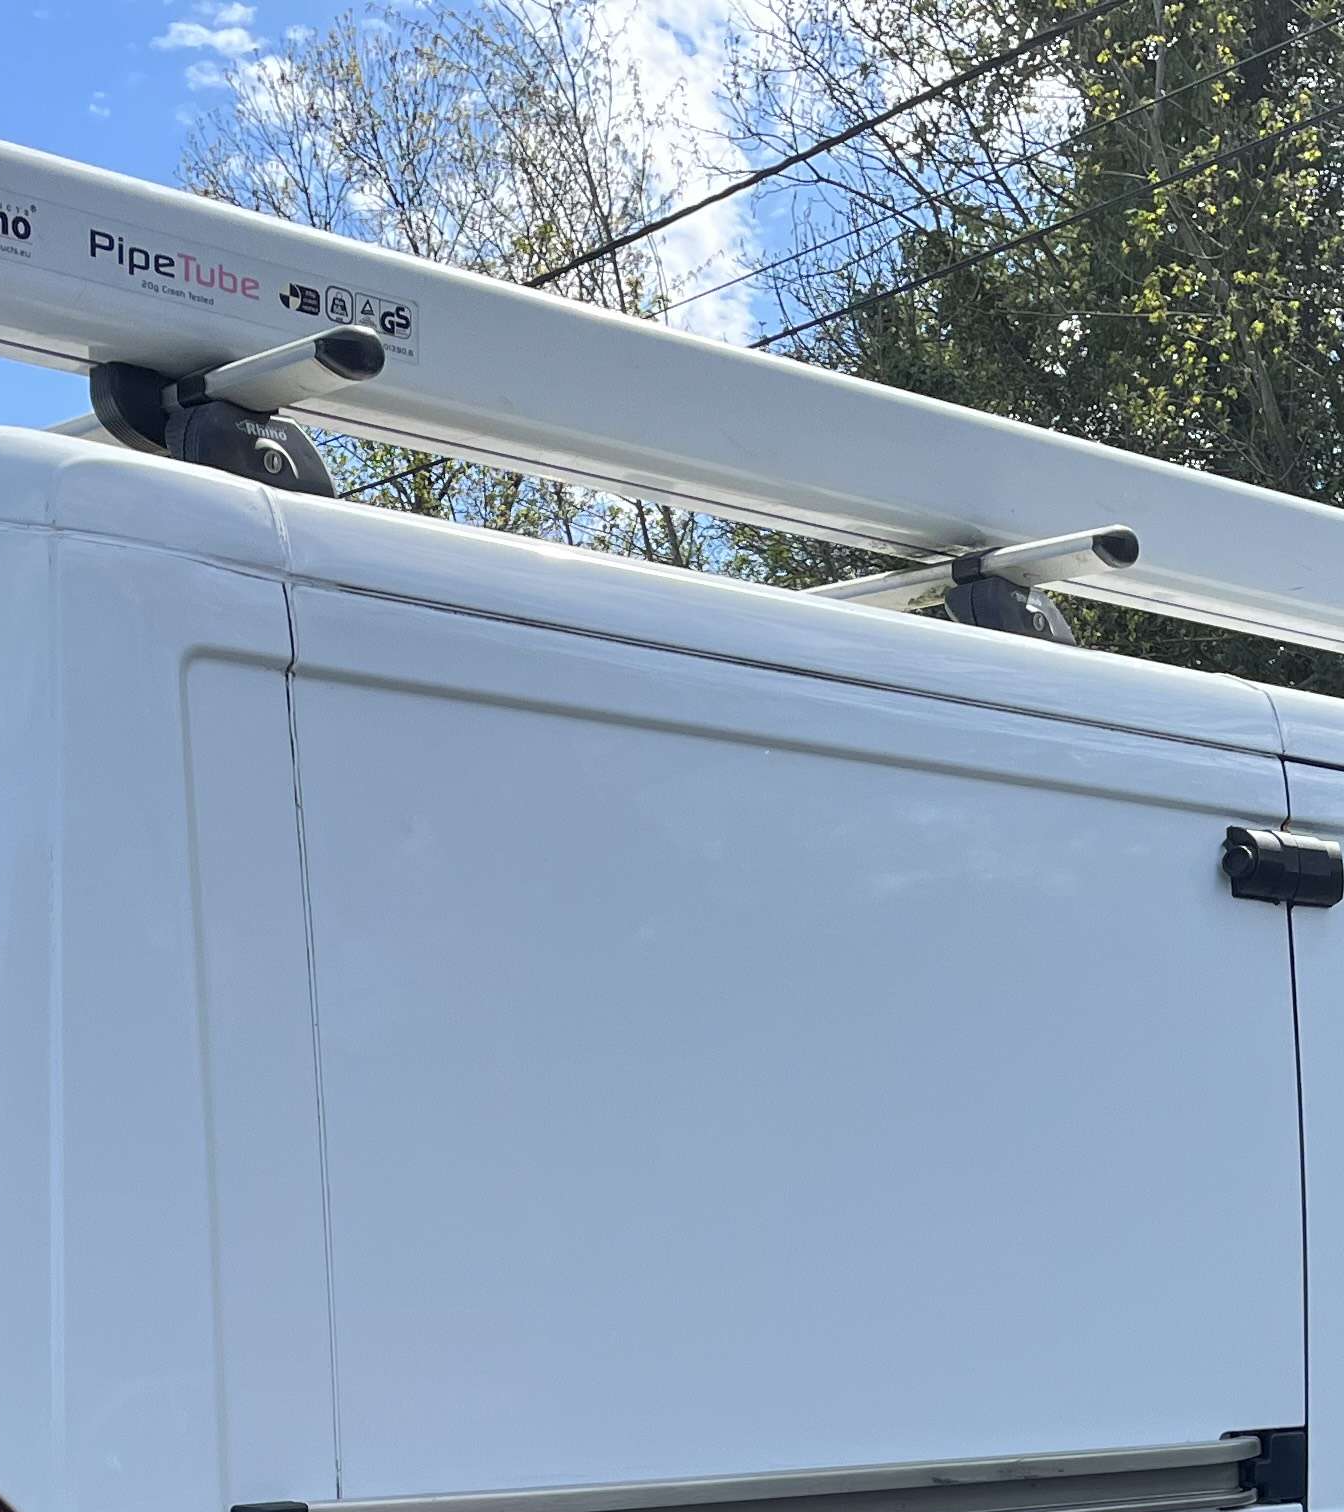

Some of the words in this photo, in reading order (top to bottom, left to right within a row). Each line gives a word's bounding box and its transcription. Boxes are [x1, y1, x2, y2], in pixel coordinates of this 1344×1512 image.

[89, 228, 260, 301] PipeTube
[380, 305, 411, 333] GS
[245, 422, 288, 441] Rhino
